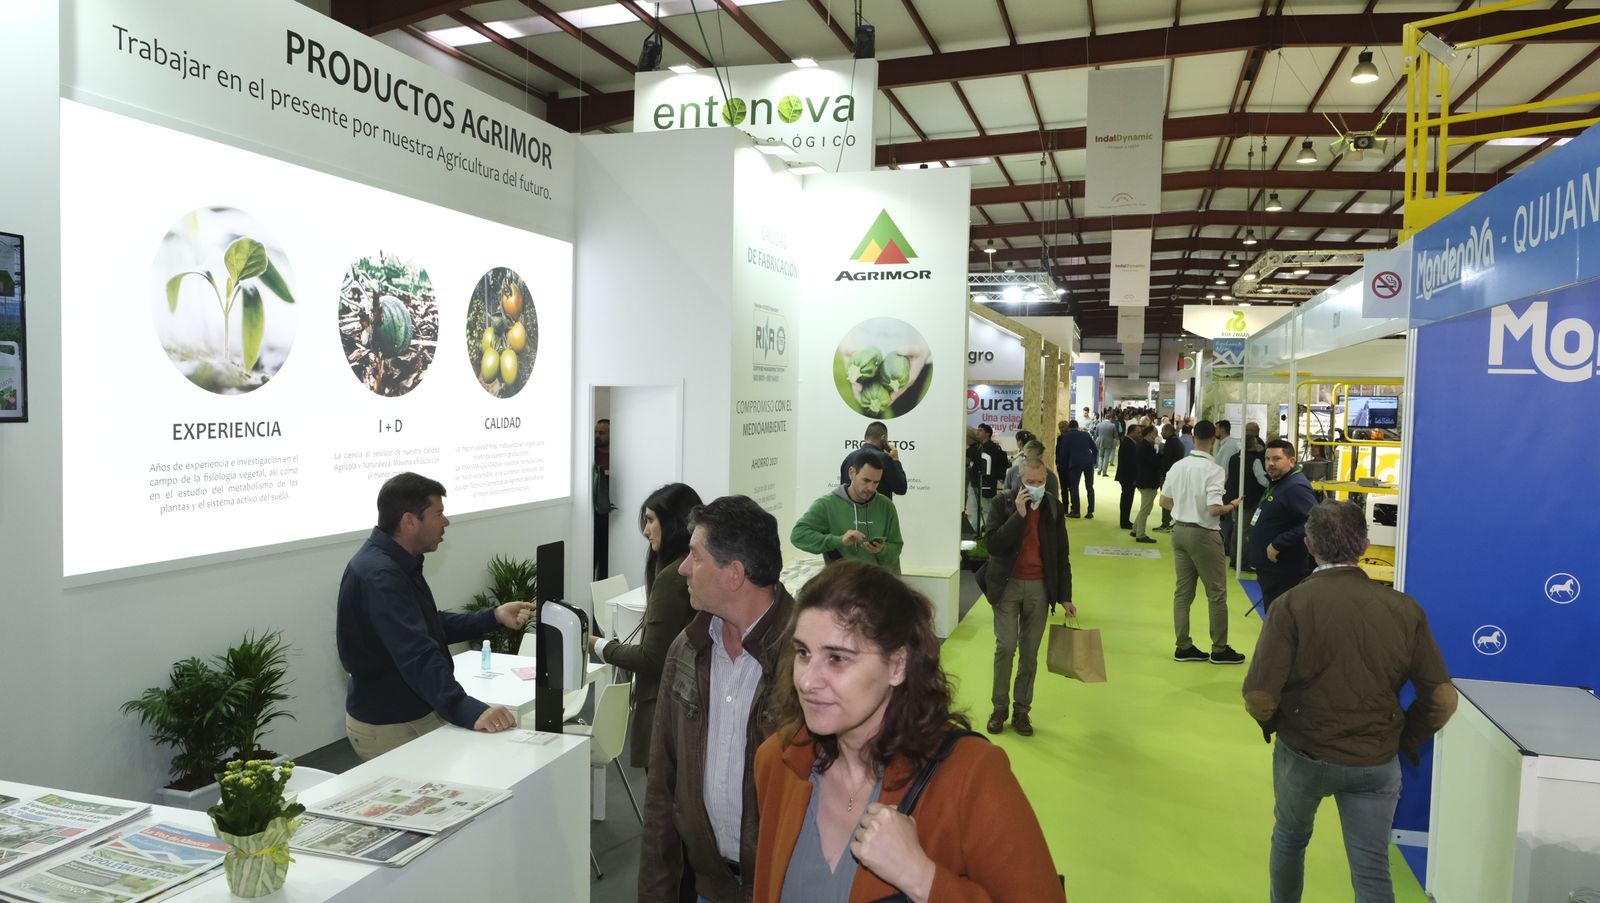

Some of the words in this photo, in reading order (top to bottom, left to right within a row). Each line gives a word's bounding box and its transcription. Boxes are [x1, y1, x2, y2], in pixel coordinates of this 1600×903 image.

[286, 29, 455, 129] PRODUCTOS
[460, 108, 553, 170] AGRIMOR
[112, 24, 211, 80] Trabajar
[217, 69, 242, 92] en
[248, 78, 264, 100] el
[271, 88, 348, 128] presente
[352, 117, 379, 138] por
[383, 129, 434, 159] nuestra
[437, 145, 500, 181] Agricultura
[502, 169, 517, 187] del
[520, 174, 552, 200] futuro.
[1095, 133, 1153, 144] IndalDynamic
[1513, 166, 1600, 255] QUIJAN
[748, 247, 757, 265] DE
[834, 270, 932, 281] AGRIMOR
[1488, 301, 1600, 383] Mo
[736, 400, 775, 415] COMPROMISO
[775, 400, 786, 412] CON
[786, 400, 792, 411] EL
[385, 423, 391, 432] +
[395, 419, 403, 433] D
[484, 417, 521, 429] CALIDAD
[982, 413, 998, 422] Una
[172, 421, 282, 440] EXPERIENCIA
[742, 420, 787, 436] MEDIOAMBIENTE
[844, 439, 916, 451] PROTOS
[149, 463, 171, 472] Años
[172, 461, 183, 471] de
[185, 458, 229, 471] experiencia
[237, 455, 282, 467] investigación
[292, 454, 299, 462] el
[149, 477, 178, 487] campo
[181, 474, 191, 484] de
[193, 473, 201, 482] la
[203, 471, 237, 482] fisiología
[239, 469, 267, 480] vegetal,
[280, 467, 299, 475] como
[149, 492, 160, 500] en
[165, 490, 173, 499] el
[178, 487, 208, 497] estudio
[212, 485, 224, 494] del
[228, 481, 273, 493] metabolismo
[277, 480, 286, 488] de
[289, 479, 299, 487] las
[160, 502, 190, 516] plantas
[198, 500, 205, 509] el
[206, 498, 235, 508] sistema
[236, 495, 258, 505] activo
[259, 493, 270, 502] del
